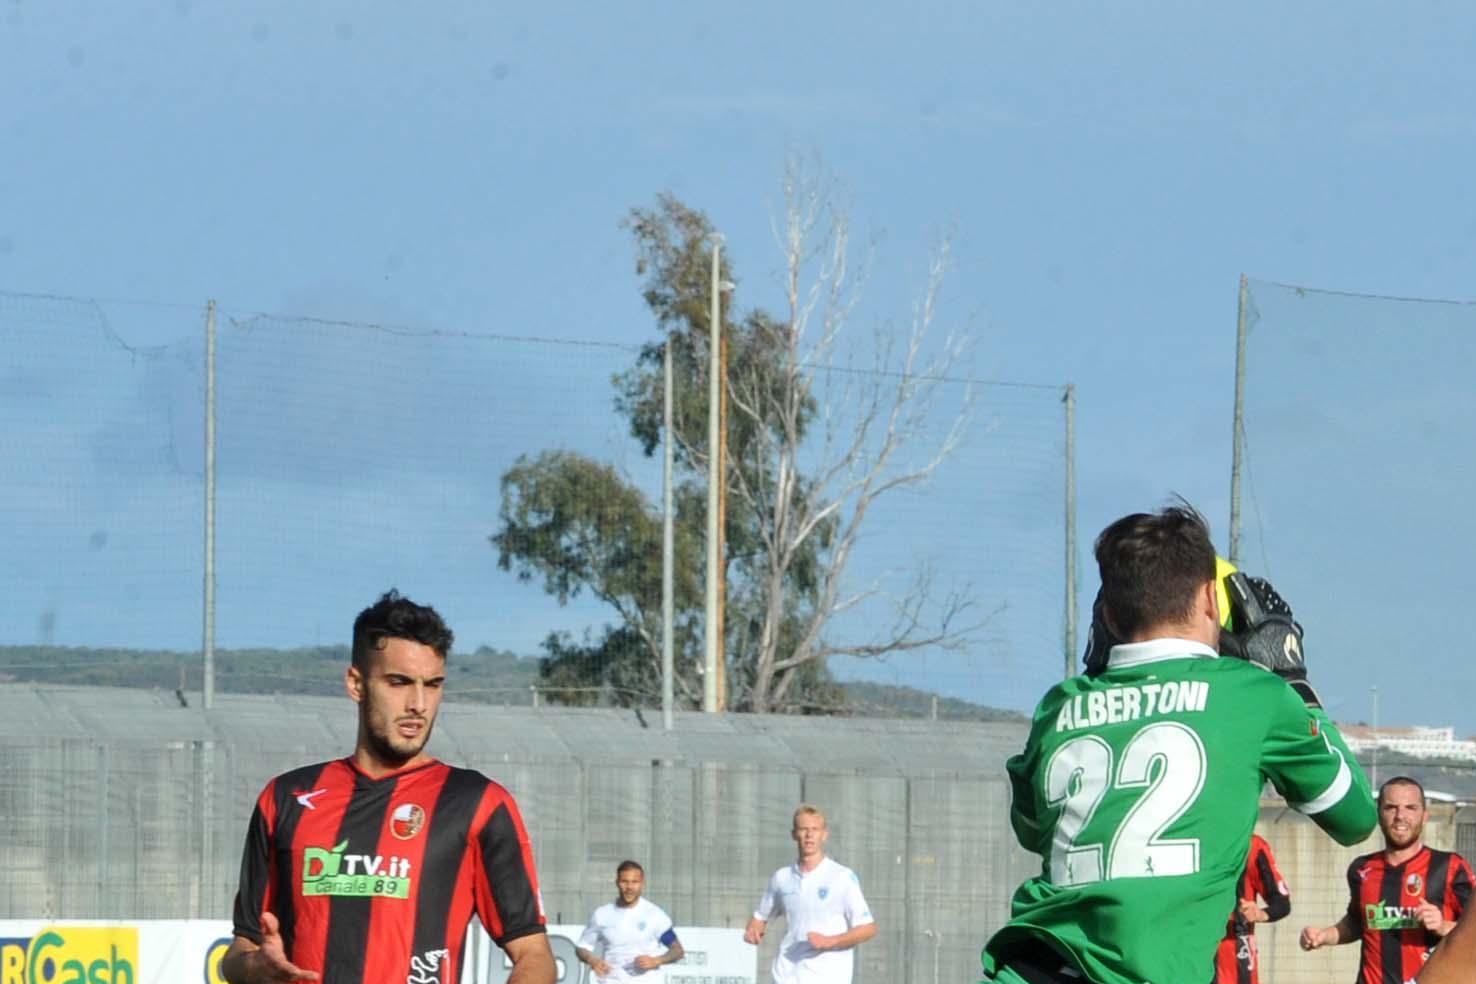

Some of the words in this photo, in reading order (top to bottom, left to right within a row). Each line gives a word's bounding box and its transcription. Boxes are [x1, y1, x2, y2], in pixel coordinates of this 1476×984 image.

[1055, 681, 1209, 732] ALBERTONI
[1045, 721, 1208, 888] 22
[314, 877, 367, 894] canale
[373, 875, 398, 894] 89
